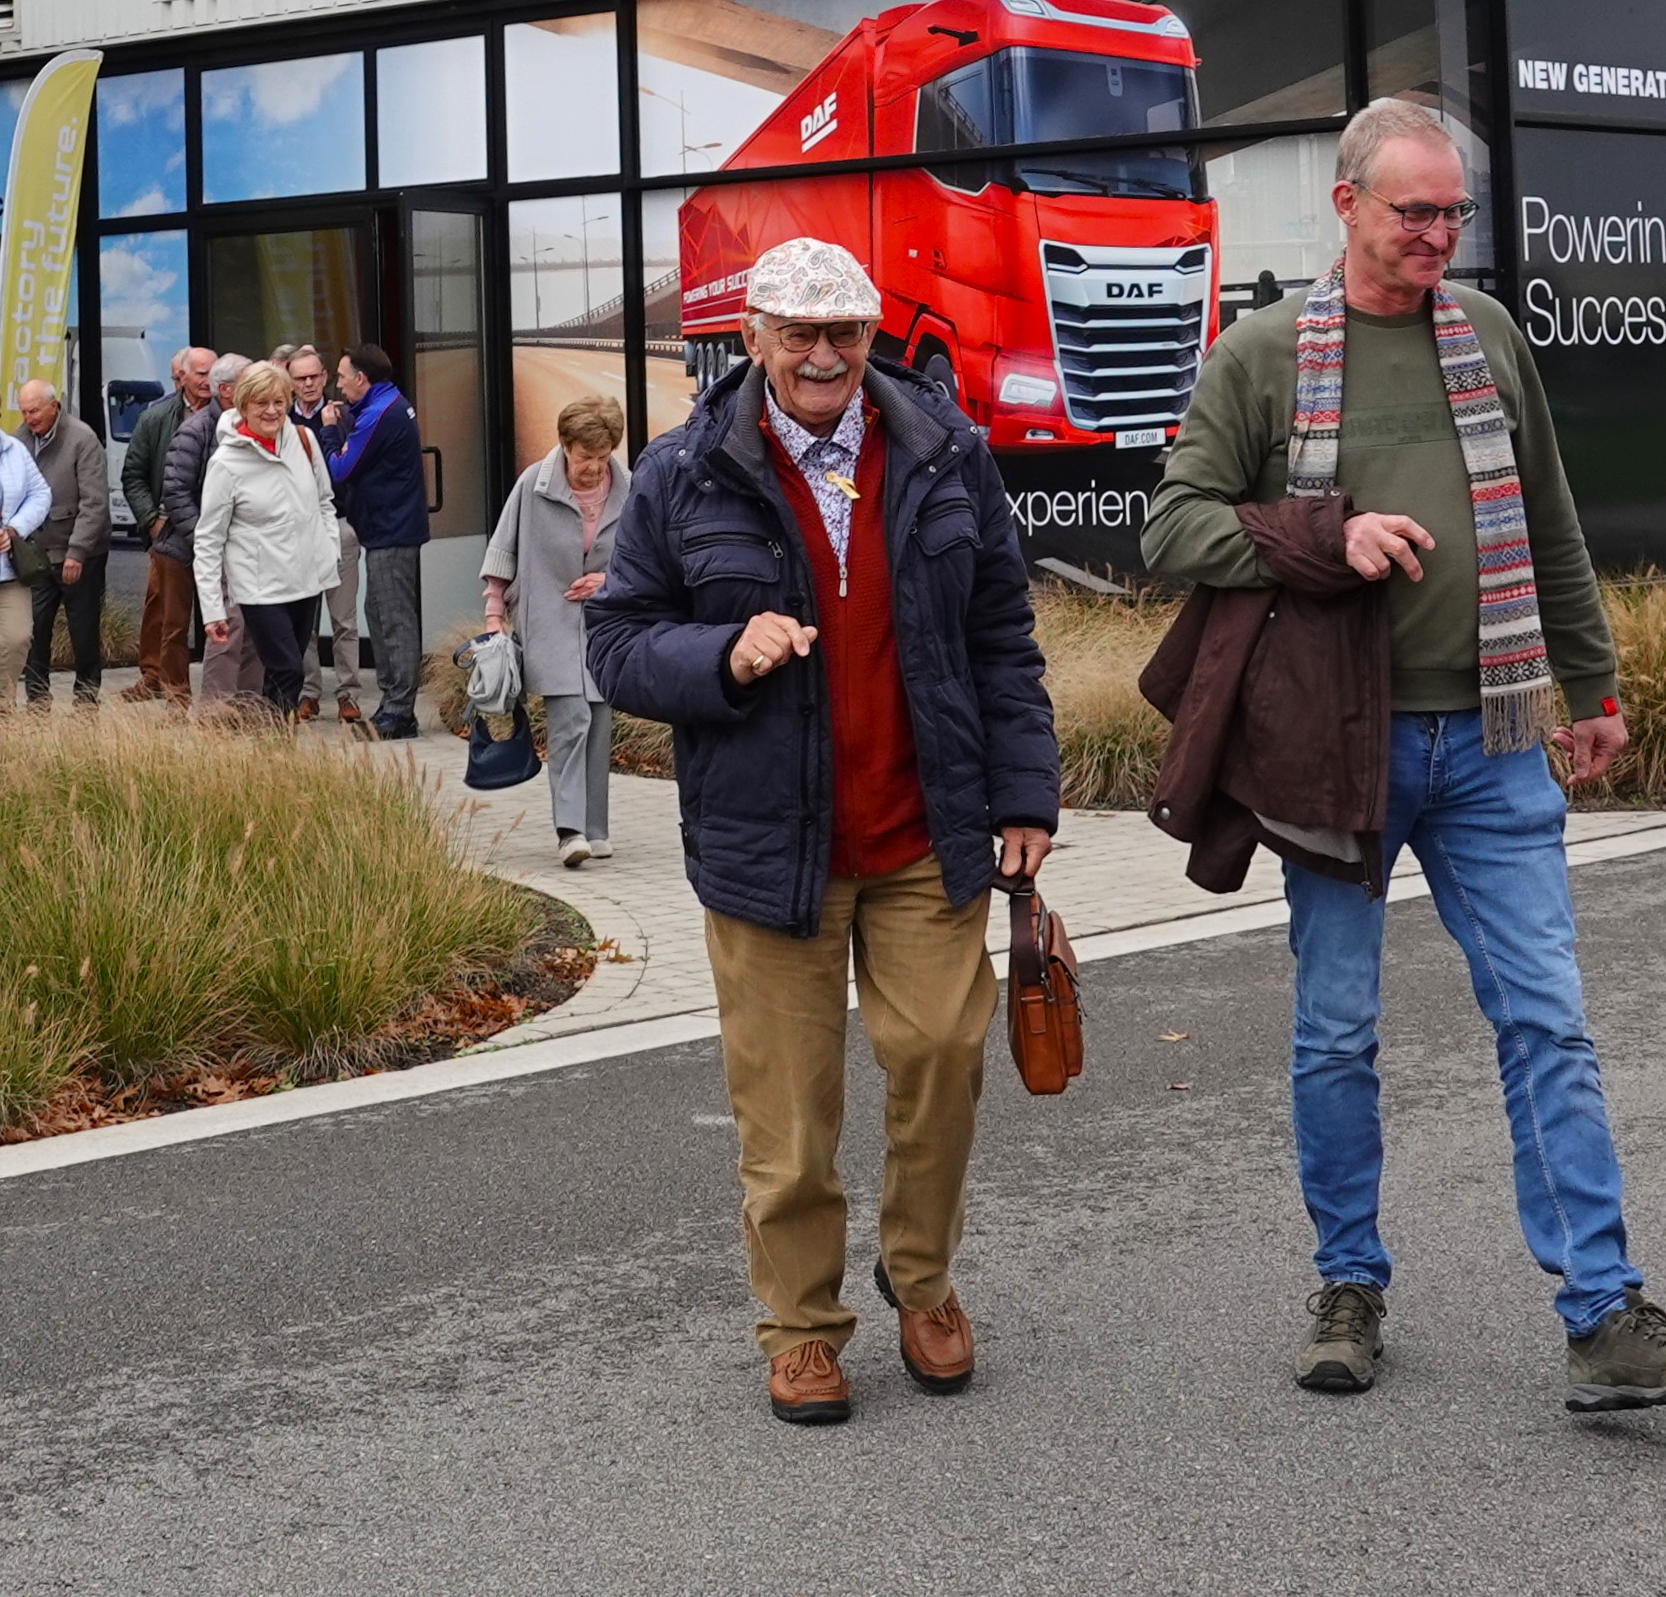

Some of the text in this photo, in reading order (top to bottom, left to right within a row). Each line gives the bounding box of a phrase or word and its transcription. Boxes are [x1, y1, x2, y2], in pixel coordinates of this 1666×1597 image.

[1518, 59, 1567, 91] NEW
[801, 91, 837, 141] DAF
[36, 116, 78, 365] the future.
[6, 220, 45, 411] Factory
[1106, 282, 1163, 299] DAF
[1125, 431, 1158, 445] DAF.COM
[1005, 479, 1149, 536] xperien
